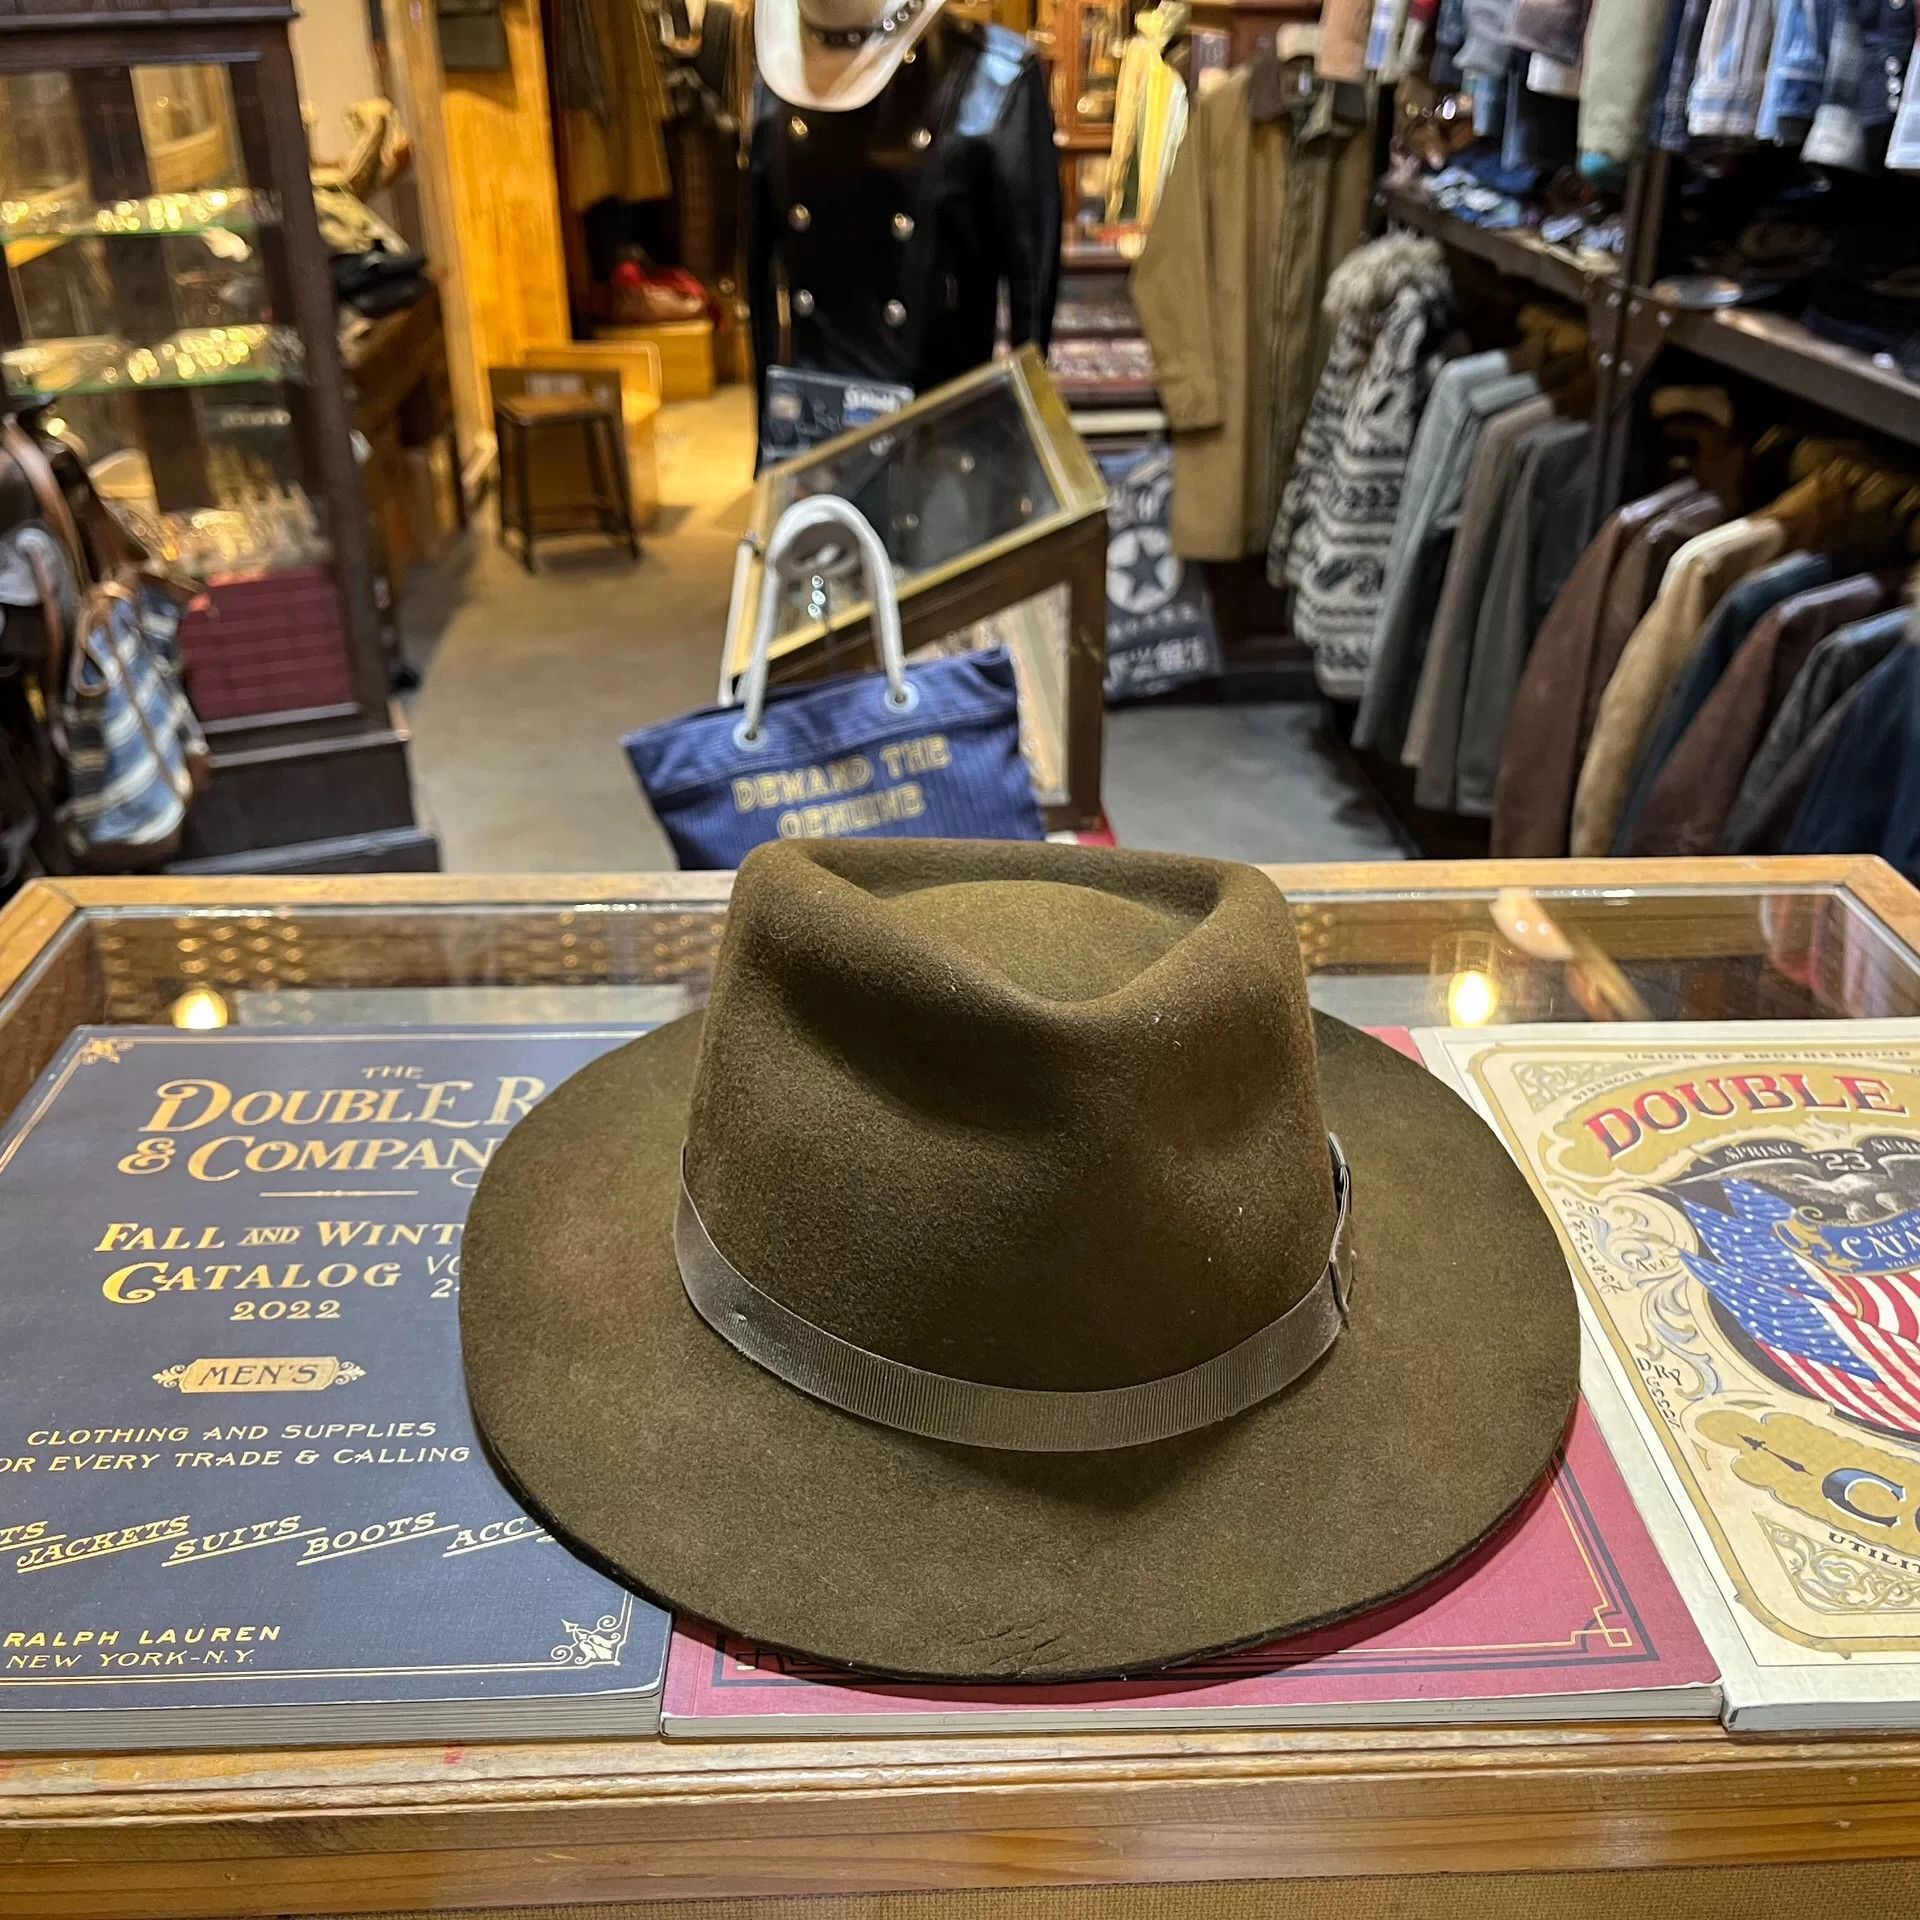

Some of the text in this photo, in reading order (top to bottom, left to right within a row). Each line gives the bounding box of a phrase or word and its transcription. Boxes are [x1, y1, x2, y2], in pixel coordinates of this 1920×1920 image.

[880, 734, 951, 780] THE
[360, 1065, 424, 1080] THE
[138, 1078, 480, 1132] DOUBLE
[1582, 1073, 1910, 1161] DOUBLE
[117, 1135, 504, 1189] & COMPAN
[1725, 1142, 1793, 1164] SPRING
[1812, 1152, 1873, 1171] '23
[94, 1222, 226, 1252] FALL
[236, 1226, 302, 1246] AND
[102, 1261, 402, 1304] CATALOG
[229, 1299, 341, 1321] 2022
[198, 1364, 319, 1386] MEN'S
[1635, 1357, 1682, 1386] DRY
[27, 1422, 437, 1446] CLOTHING AND SUPPLIES
[48, 1453, 160, 1471] EVERY
[175, 1450, 283, 1469] TRADE
[295, 1449, 320, 1465] &
[333, 1447, 470, 1465] CALLING
[16, 1514, 191, 1568] JACKETS
[169, 1515, 302, 1561] SUITS
[302, 1511, 436, 1557] BOOTS
[3, 1626, 281, 1648] RALPH LAUREN
[5, 1653, 82, 1669] NEW
